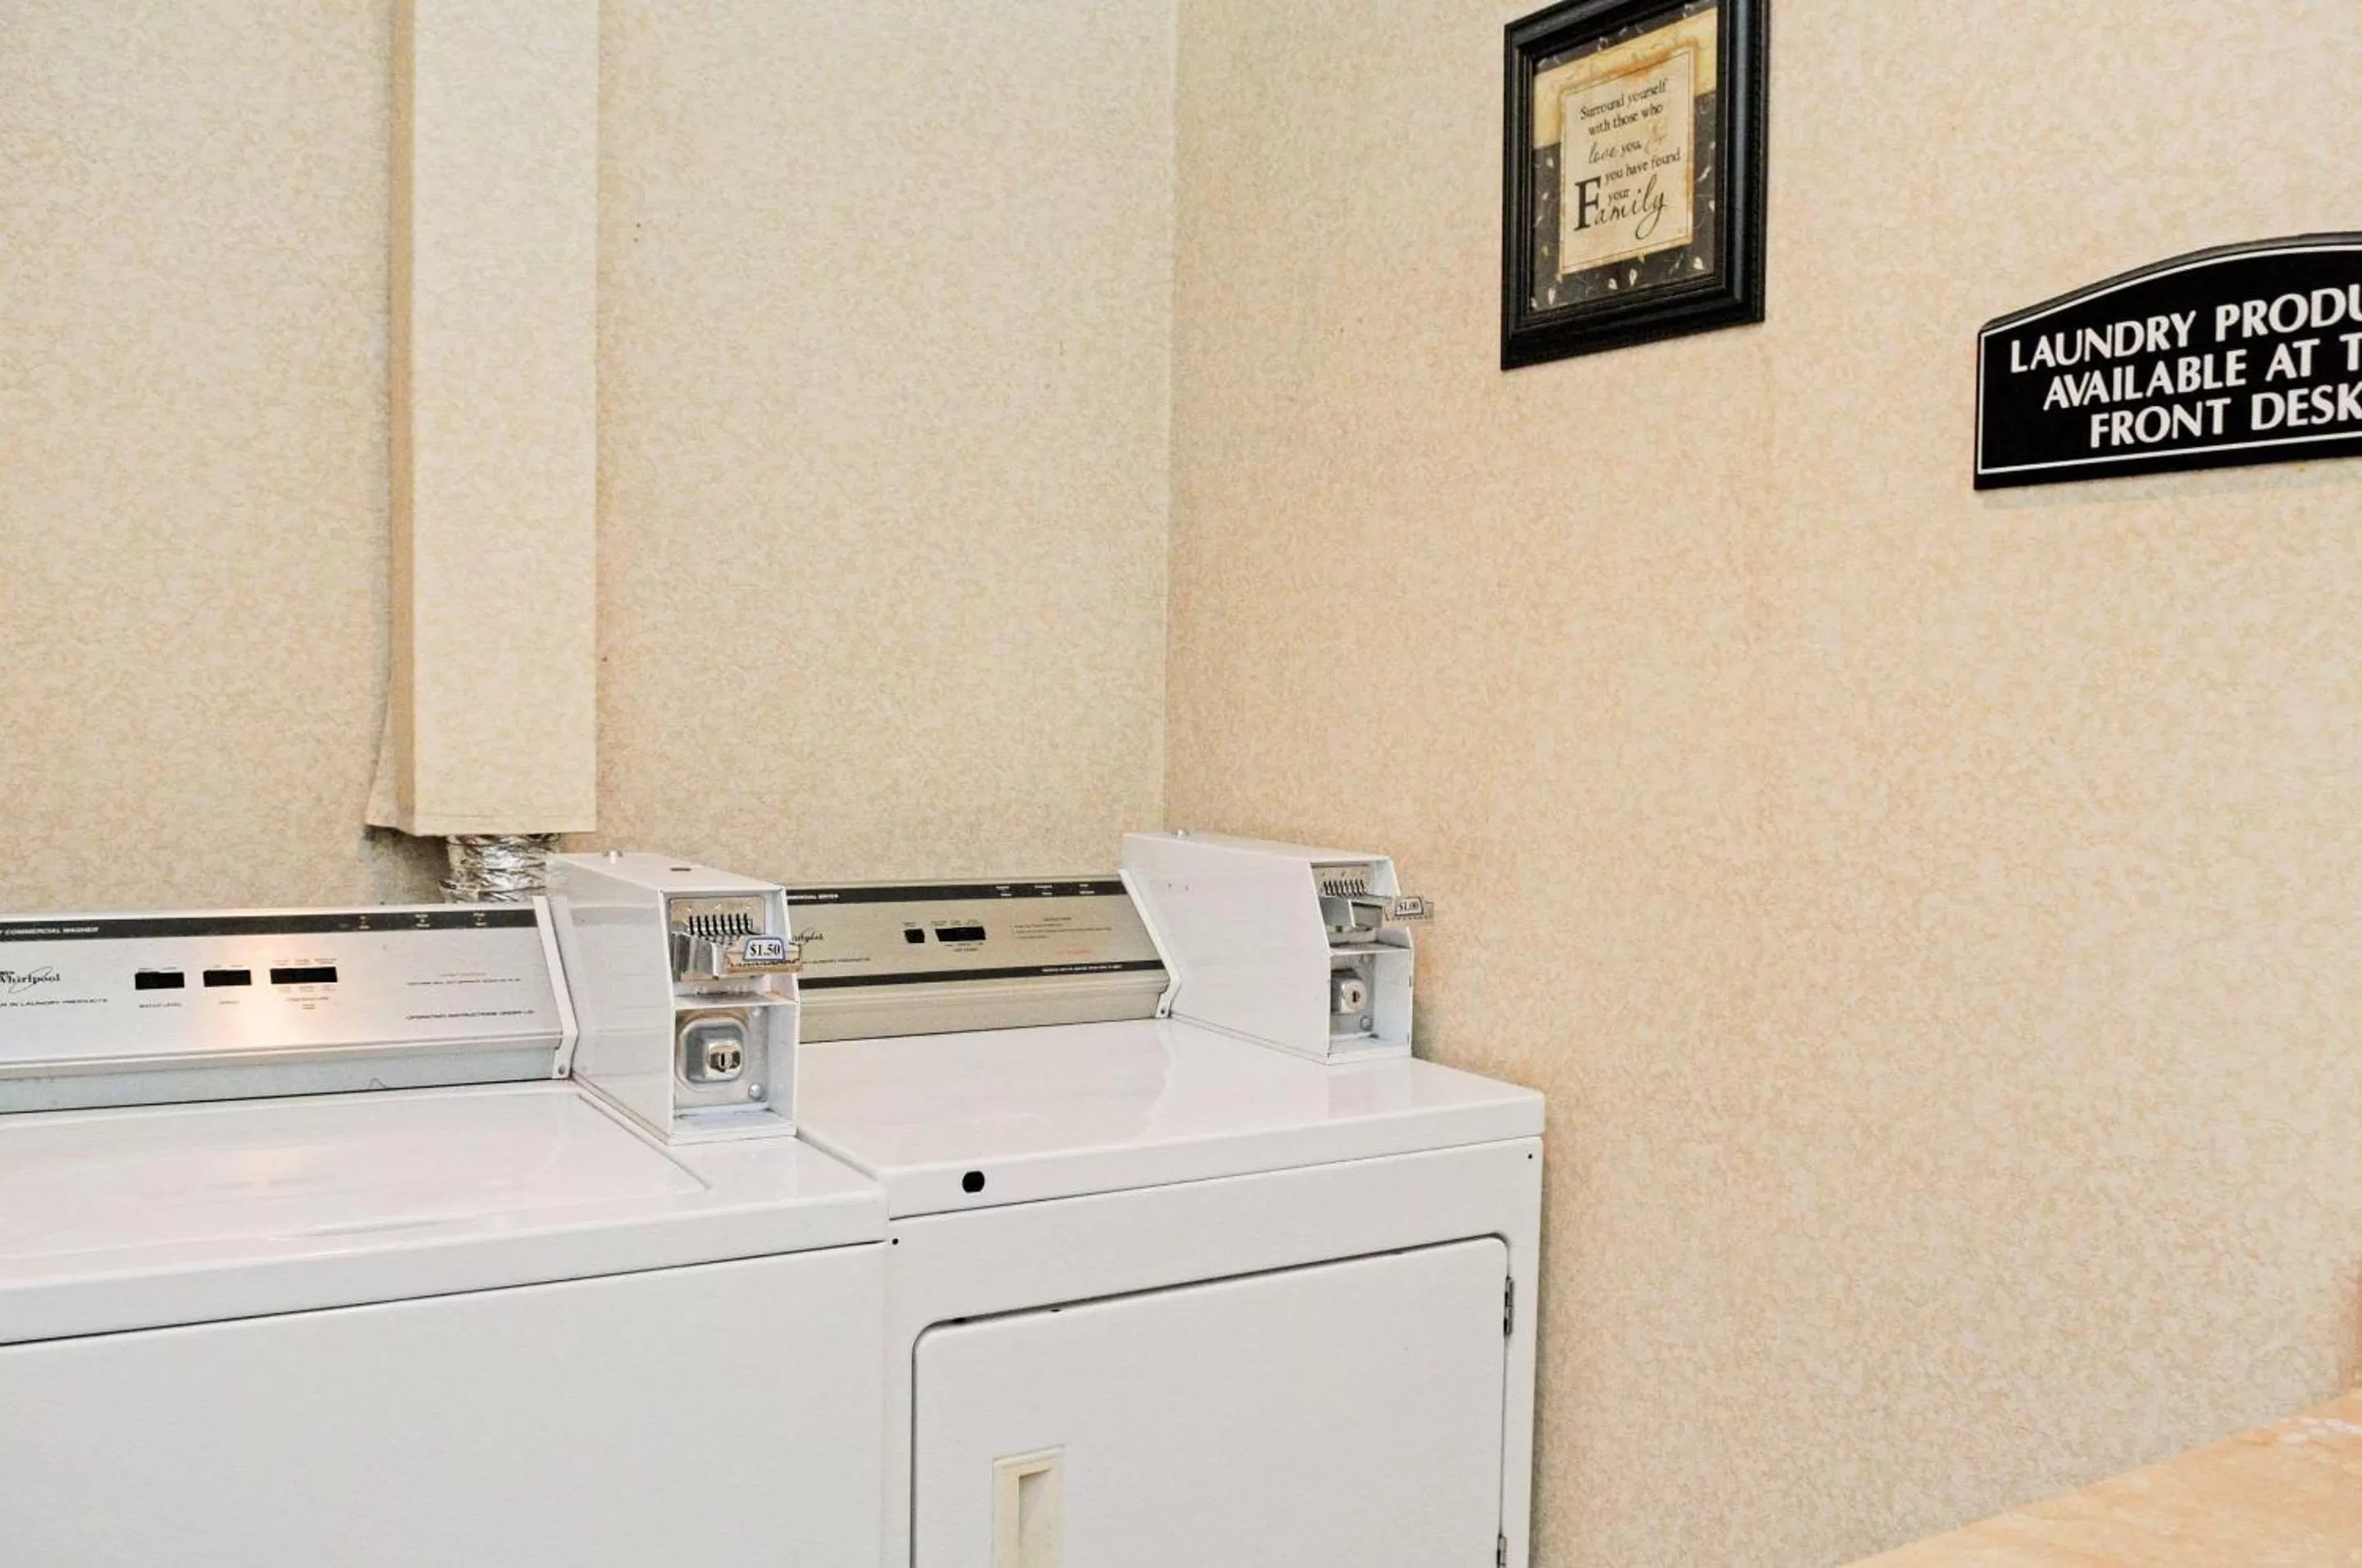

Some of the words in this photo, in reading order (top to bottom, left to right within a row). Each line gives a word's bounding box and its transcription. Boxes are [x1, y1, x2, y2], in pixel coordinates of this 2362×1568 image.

[1580, 93, 1625, 120] Surround
[1626, 78, 1667, 108] yourself
[1588, 119, 1611, 135] with
[1613, 113, 1639, 129] those
[1641, 103, 1663, 118] who
[1605, 169, 1624, 185] you
[1626, 161, 1648, 176] have
[1650, 147, 1680, 169] found
[1608, 189, 1630, 206] your
[2010, 310, 2196, 374] LAUNDRY
[2043, 349, 2248, 411] AVAILABLE
[2264, 338, 2321, 382] AT
[2090, 397, 2232, 449] FRONT
[2250, 381, 2362, 431] DESK
[750, 943, 781, 956] $1.50
